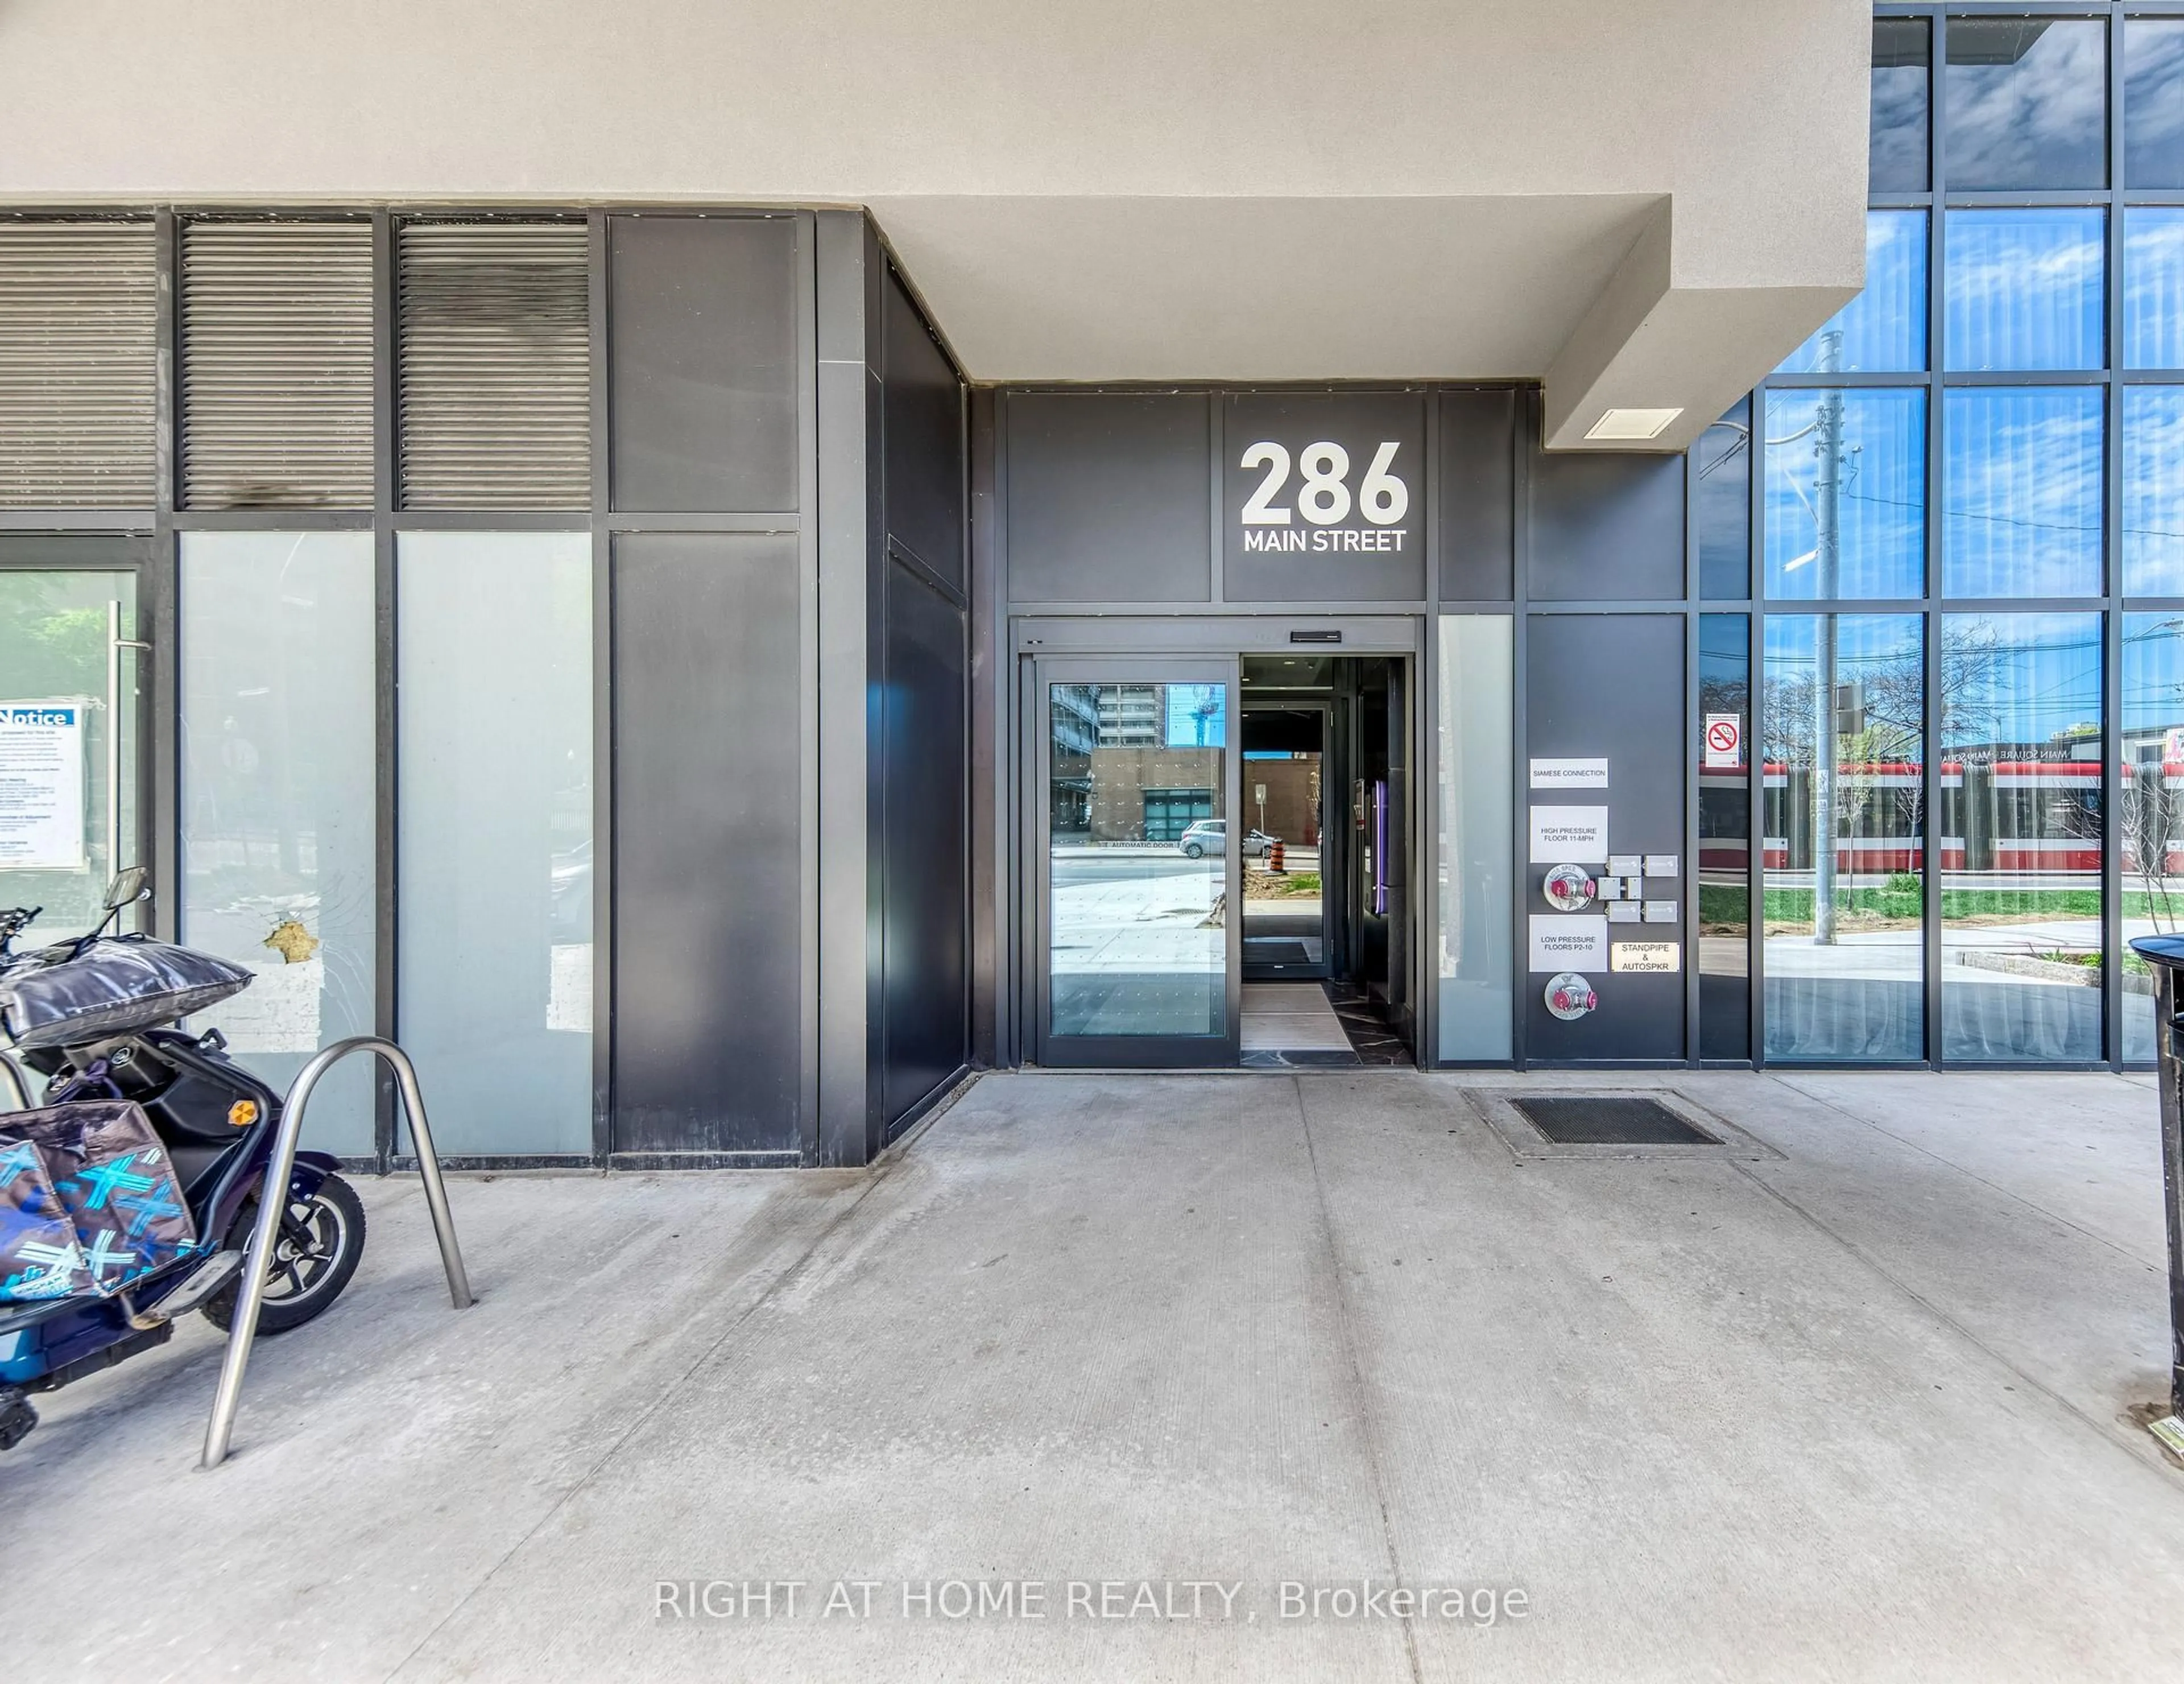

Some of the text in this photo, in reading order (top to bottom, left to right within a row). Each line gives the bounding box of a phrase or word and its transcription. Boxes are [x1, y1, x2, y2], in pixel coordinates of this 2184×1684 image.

[1240, 441, 1408, 525] 286
[1244, 530, 1407, 552] MAIN STREET
